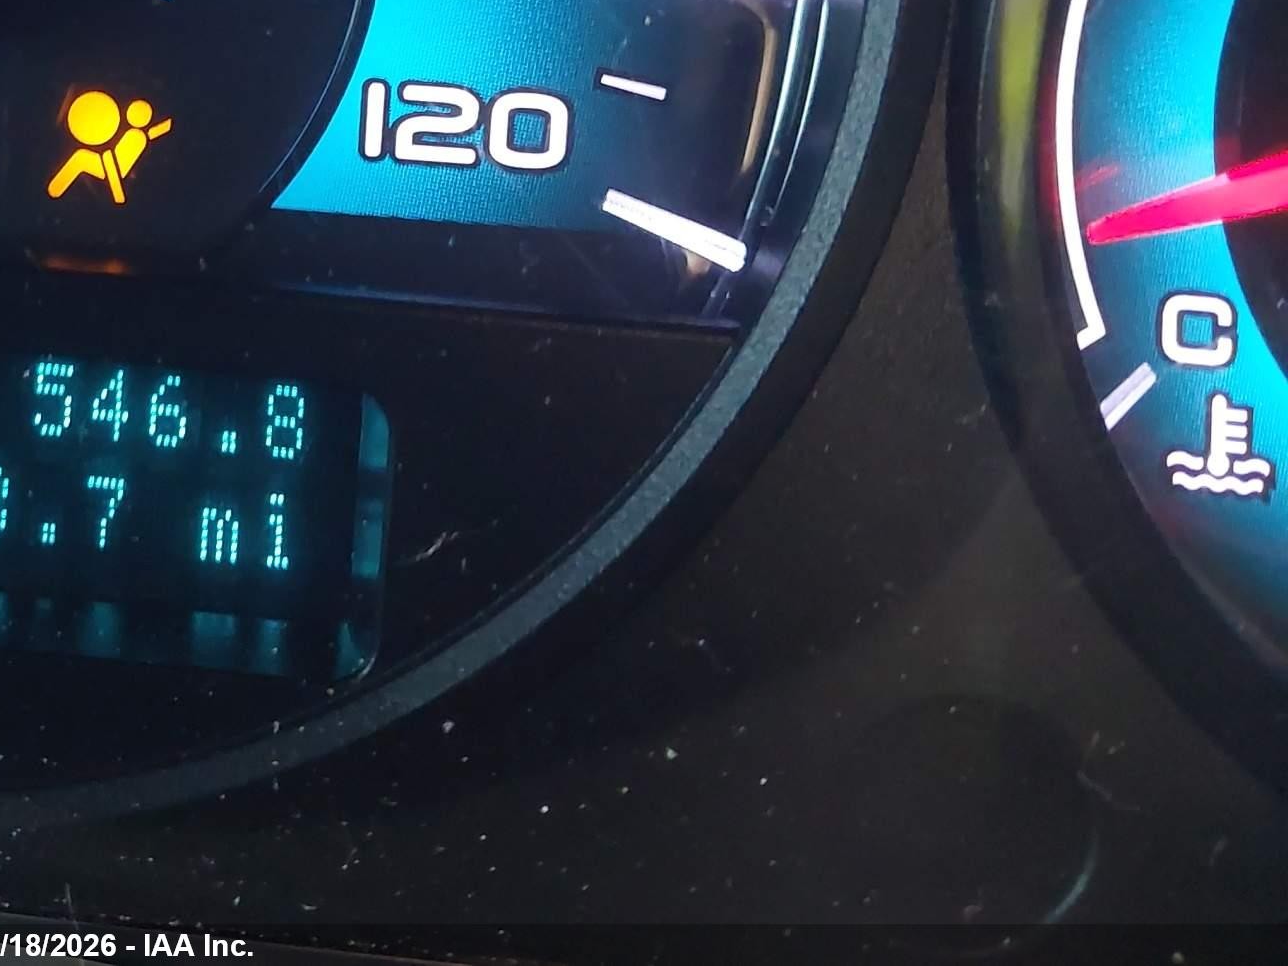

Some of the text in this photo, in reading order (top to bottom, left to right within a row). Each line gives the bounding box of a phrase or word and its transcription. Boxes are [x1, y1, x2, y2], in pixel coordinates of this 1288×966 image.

[361, 81, 572, 171] 120
[1160, 294, 1237, 367] C
[32, 361, 305, 460] 546.8
[200, 492, 290, 570] mi
